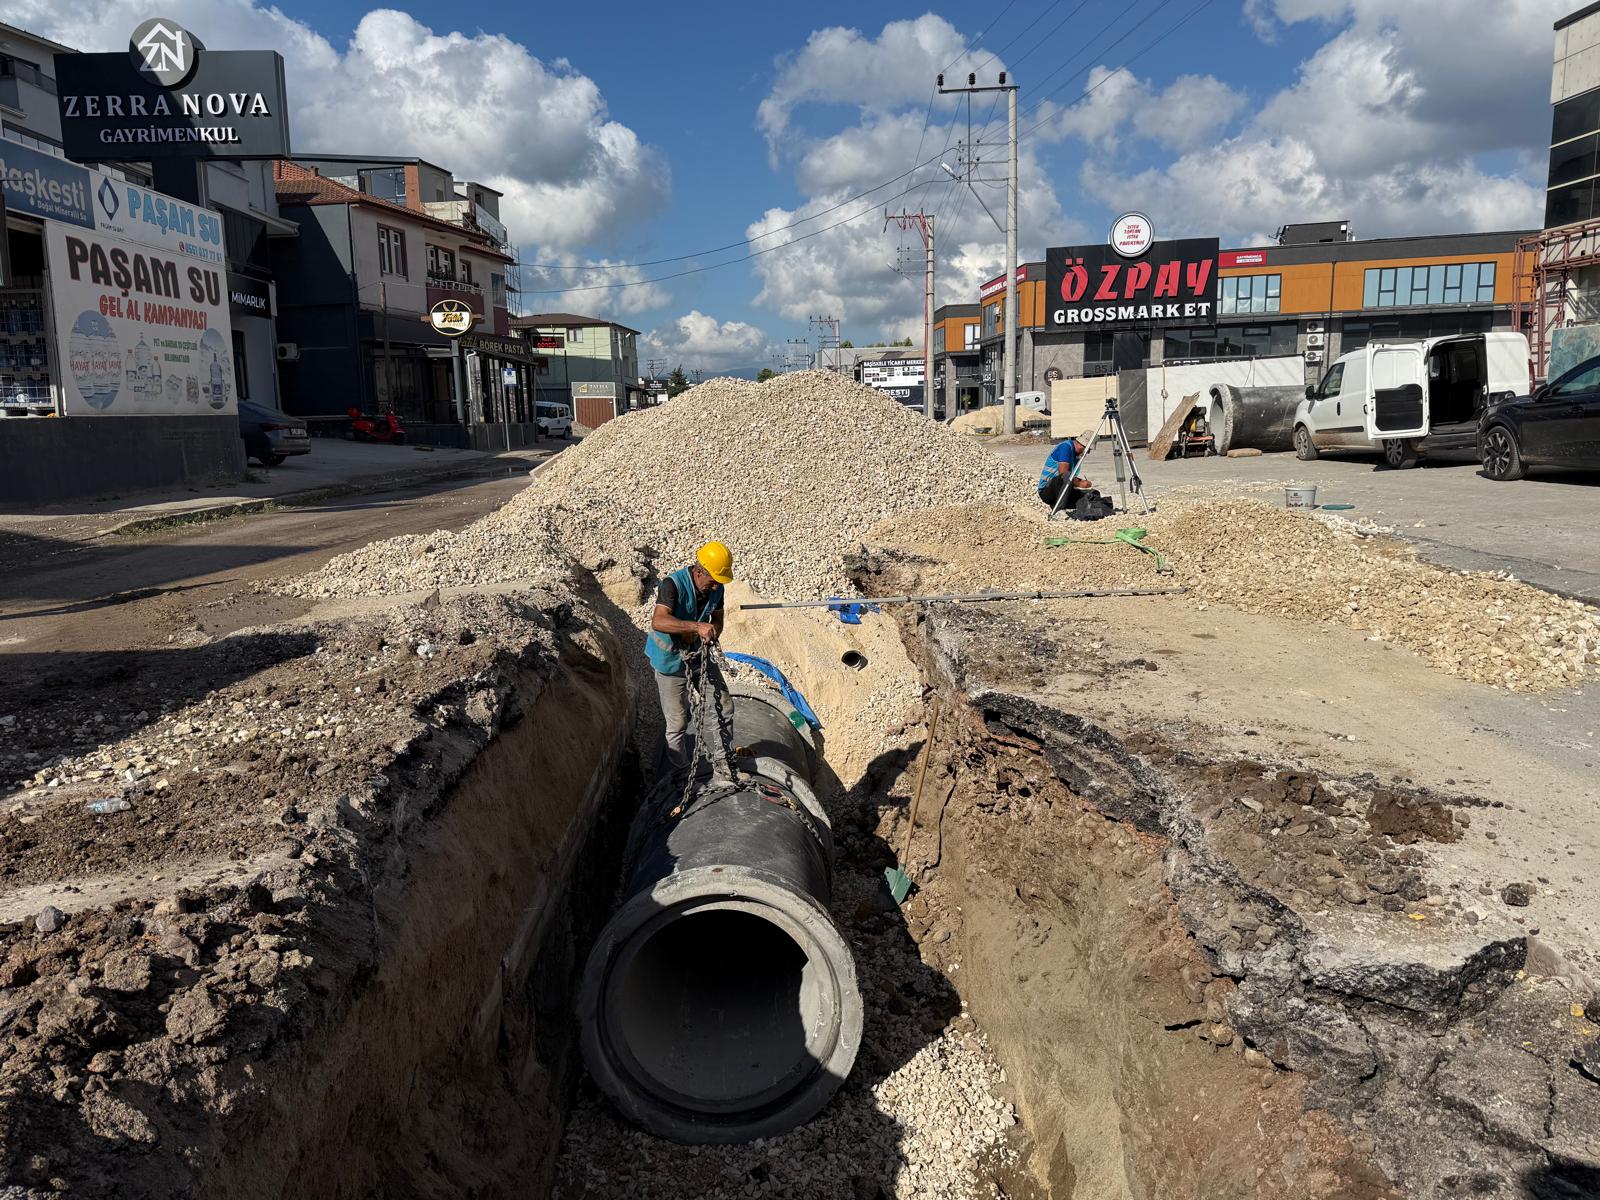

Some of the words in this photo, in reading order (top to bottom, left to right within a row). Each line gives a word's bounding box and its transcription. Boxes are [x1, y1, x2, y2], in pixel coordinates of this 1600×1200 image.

[63, 94, 172, 118] ZERRA
[182, 92, 270, 116] NOVA
[100, 125, 239, 144] GAYRİMENKUL
[127, 187, 196, 238] PAŞAM
[198, 213, 221, 246] SU
[65, 235, 181, 300] PAŞAM
[187, 264, 221, 306] SU
[1060, 257, 1214, 303] ÖZPAY
[99, 294, 124, 318] GEL
[126, 299, 141, 322] AL
[144, 302, 208, 331] KAMPANYASI
[1053, 302, 1212, 325] GROSSMARKET
[504, 343, 525, 355] PASTA
